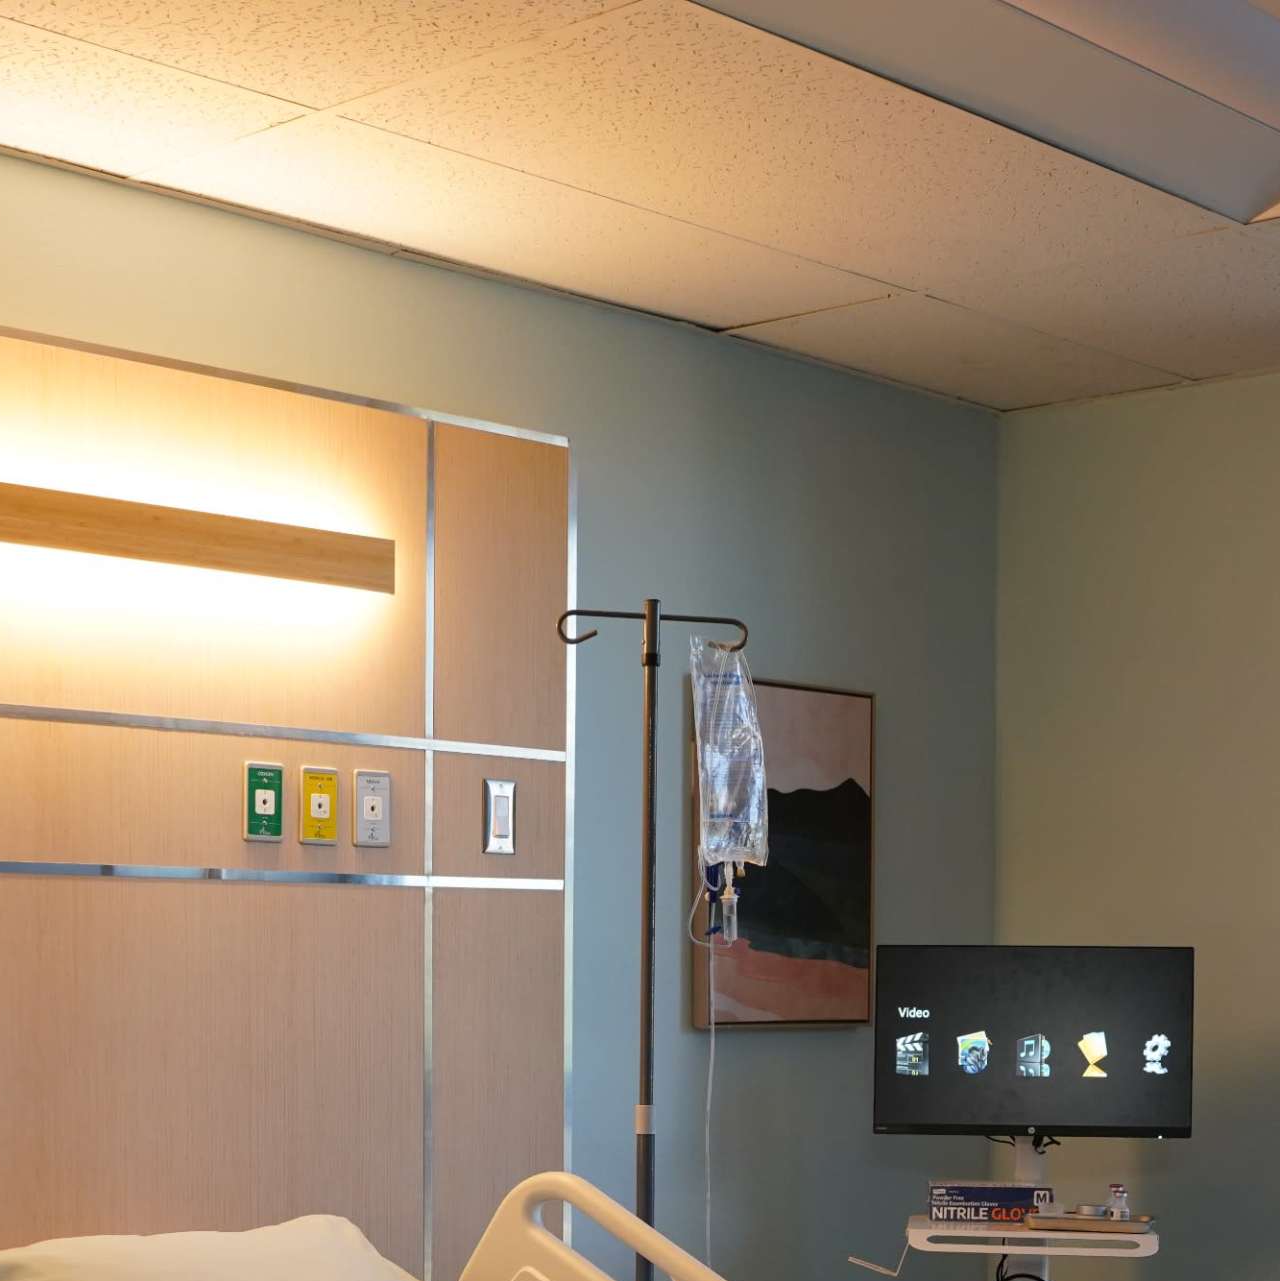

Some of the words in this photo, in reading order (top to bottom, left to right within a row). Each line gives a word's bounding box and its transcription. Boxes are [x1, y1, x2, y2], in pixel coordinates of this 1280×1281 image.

[898, 1007, 930, 1018] Video
[1037, 1192, 1046, 1202] M
[932, 1207, 989, 1220] NITRILE
